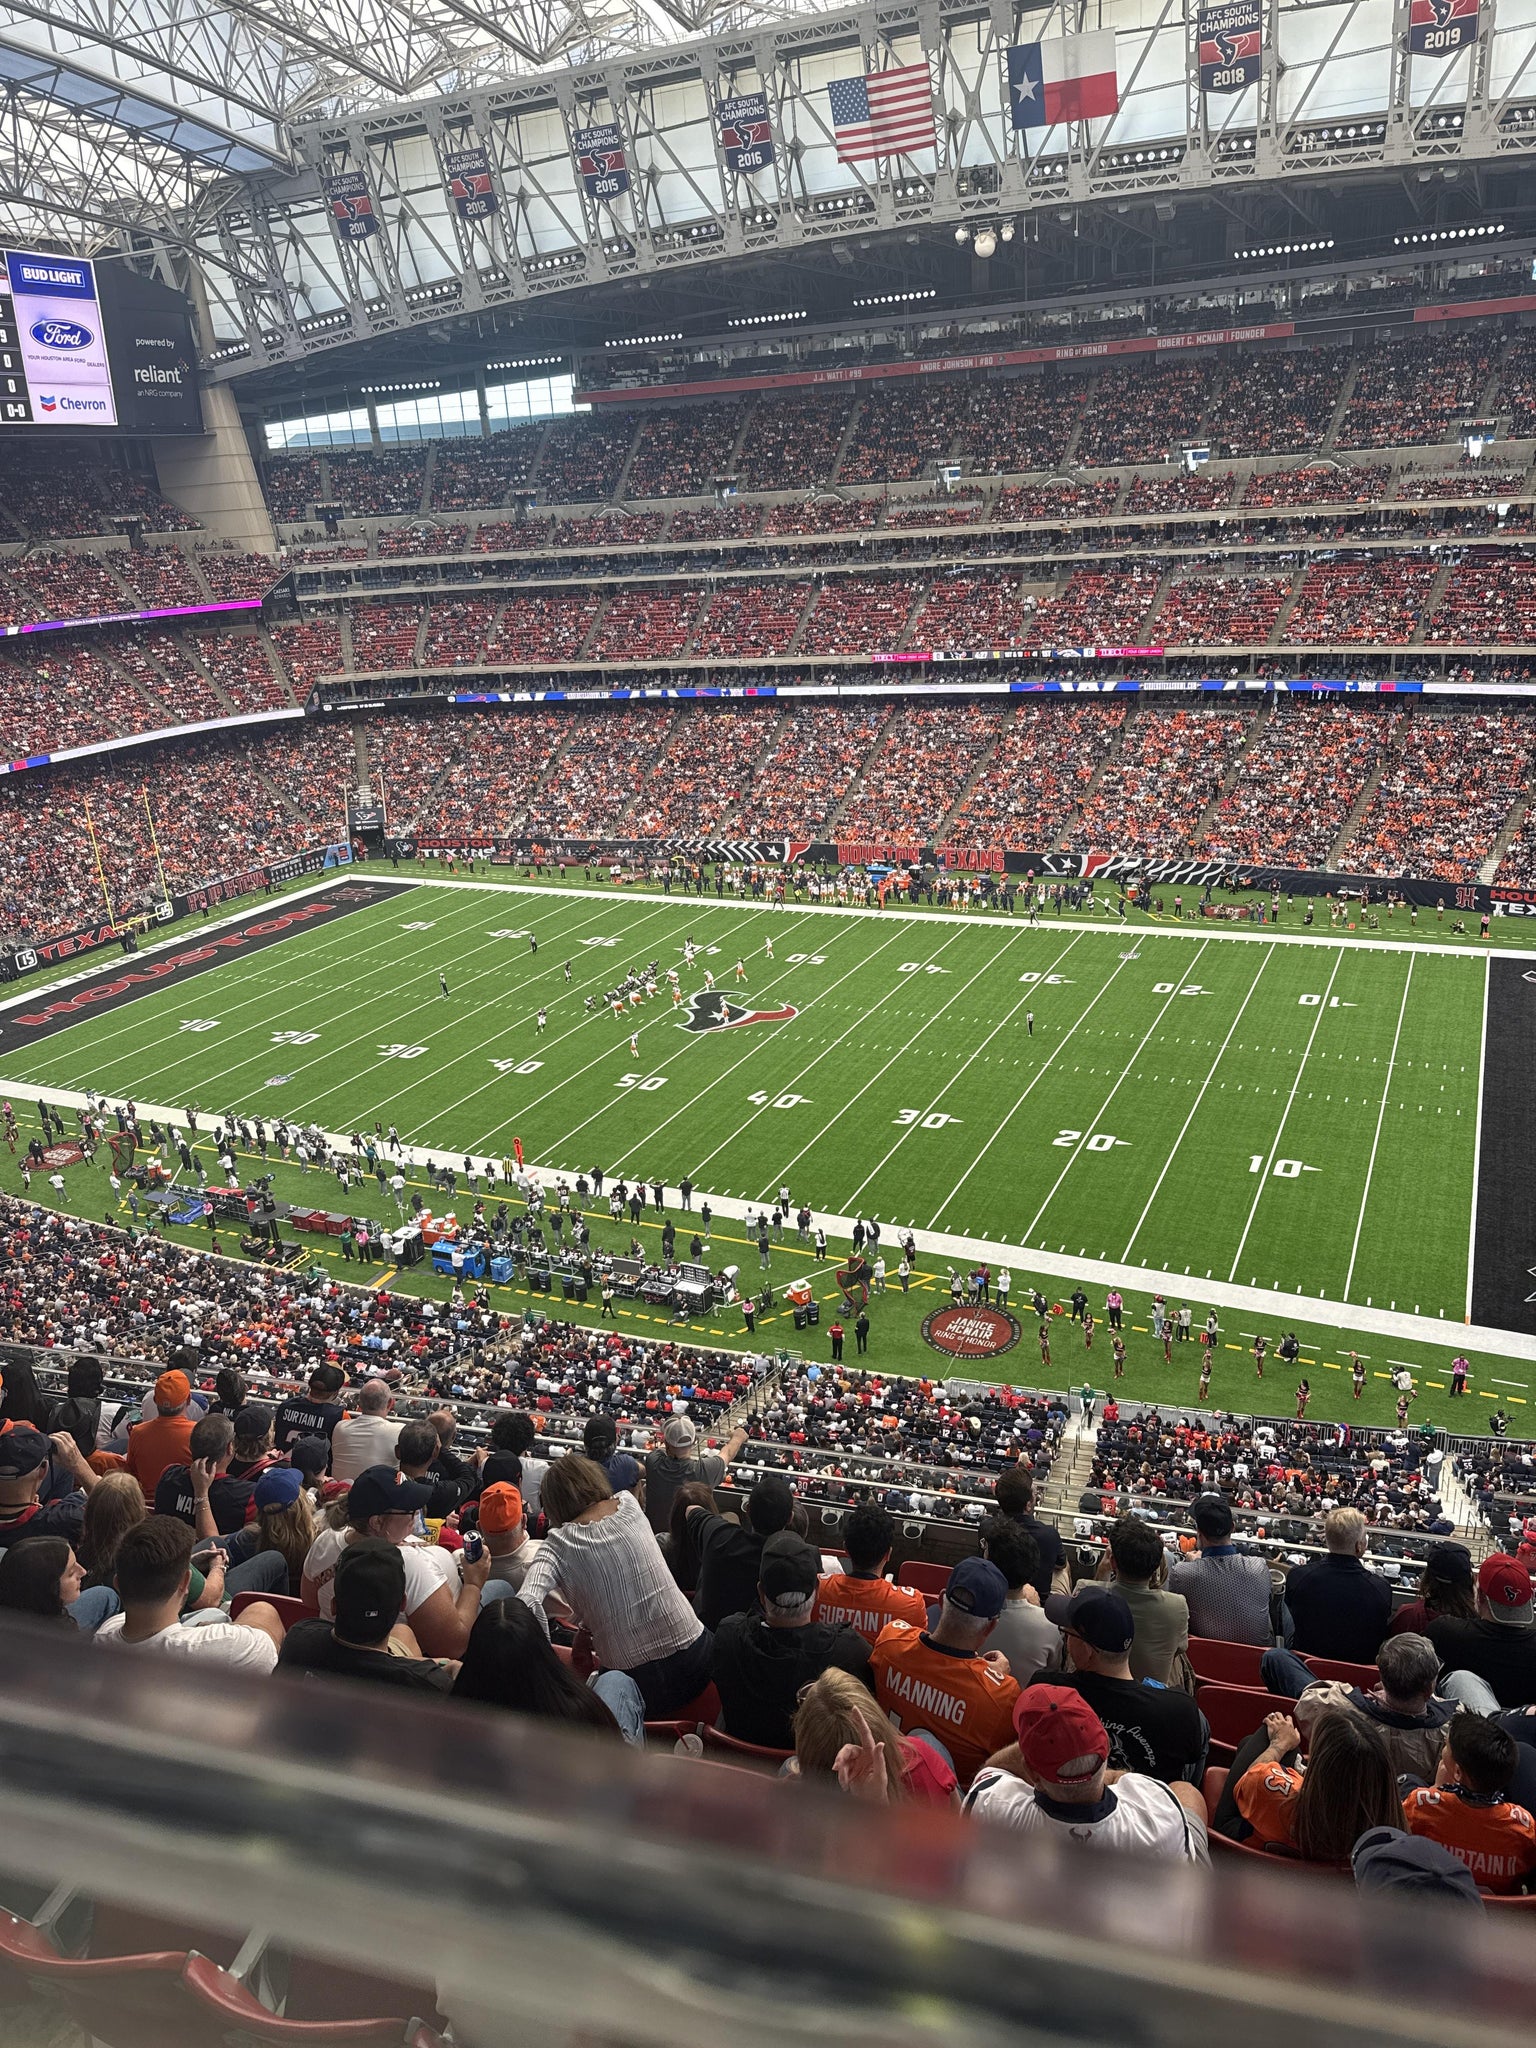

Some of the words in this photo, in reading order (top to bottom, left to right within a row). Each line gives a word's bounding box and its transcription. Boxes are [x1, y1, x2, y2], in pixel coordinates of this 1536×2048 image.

[1206, 11, 1222, 21] AFC
[1223, 4, 1253, 18] SOUTH
[1199, 12, 1260, 32] CHAMPIONS
[1424, 27, 1461, 49] 2019
[1212, 68, 1245, 87] 2018
[724, 102, 736, 111] AFC
[737, 97, 759, 109] SOUTH
[720, 104, 765, 122] CHAMPIONS
[580, 131, 591, 140] AFC
[592, 128, 613, 139] SOUTH
[577, 134, 619, 150] CHAMPIONS
[450, 155, 459, 164] AFC
[460, 152, 479, 162] SOUTH
[737, 151, 763, 168] 2016
[448, 158, 485, 174] CHAMPIONS
[329, 182, 365, 196] CHAMPIONS
[331, 179, 340, 187] AFC
[341, 176, 359, 185] SOUTH
[595, 178, 619, 194] 2015
[466, 201, 488, 215] 2012
[349, 221, 366, 234] 2011
[23, 267, 48, 281] BUD
[49, 270, 83, 285] LIGHT
[44, 323, 82, 346] Ford
[1157, 337, 1185, 348] ROBERT
[1187, 335, 1195, 346] C.
[1197, 332, 1224, 344] MCNAIR
[1231, 327, 1266, 341] FOUNDER
[136, 338, 165, 348] powered
[166, 339, 175, 349] by
[1056, 347, 1074, 358] RING
[1083, 344, 1108, 356] HONOR
[3, 354, 12, 368] 0
[919, 361, 941, 372] ANDRE
[942, 357, 974, 370] JOHNSON
[134, 365, 183, 384] reliant
[826, 371, 843, 381] WATT
[7, 379, 16, 393] 0
[144, 389, 158, 397] NRG
[158, 390, 183, 398] company
[7, 403, 26, 418] 0-0
[60, 396, 106, 411] Chevron
[418, 839, 493, 849] HOUSTON
[934, 848, 1005, 873] TEXANS
[72, 954, 135, 982] TAKES
[141, 936, 178, 956] ALL
[184, 928, 206, 939] OF
[210, 918, 234, 928] US
[12, 902, 337, 1027] HOUSTON
[784, 953, 829, 965] 50
[896, 962, 942, 974] 40
[1018, 972, 1067, 985] 30
[1152, 982, 1203, 996] 20
[1298, 994, 1342, 1008] 10
[184, 1018, 222, 1032] 10
[272, 1031, 322, 1045] 20
[380, 1044, 430, 1059] 30
[491, 1058, 545, 1075] 40
[613, 1073, 669, 1091] 50
[747, 1090, 803, 1109] 40
[891, 1108, 951, 1129] 30
[1051, 1129, 1117, 1152] 20
[1248, 1155, 1304, 1178] 10
[801, 1291, 809, 1300] G
[945, 1323, 993, 1340] MCNAIR
[951, 1316, 997, 1332] JANICE
[934, 1329, 957, 1340] RING
[965, 1336, 997, 1349] HONOR
[223, 1407, 235, 1418] NIX
[282, 1408, 315, 1427] SURTAIN
[316, 1416, 325, 1429] II
[797, 1480, 808, 1490] 80
[1080, 1525, 1086, 1534] 2
[818, 1603, 879, 1633] SURTAIN
[885, 1665, 967, 1726] MANNING
[1126, 1725, 1157, 1769] Average
